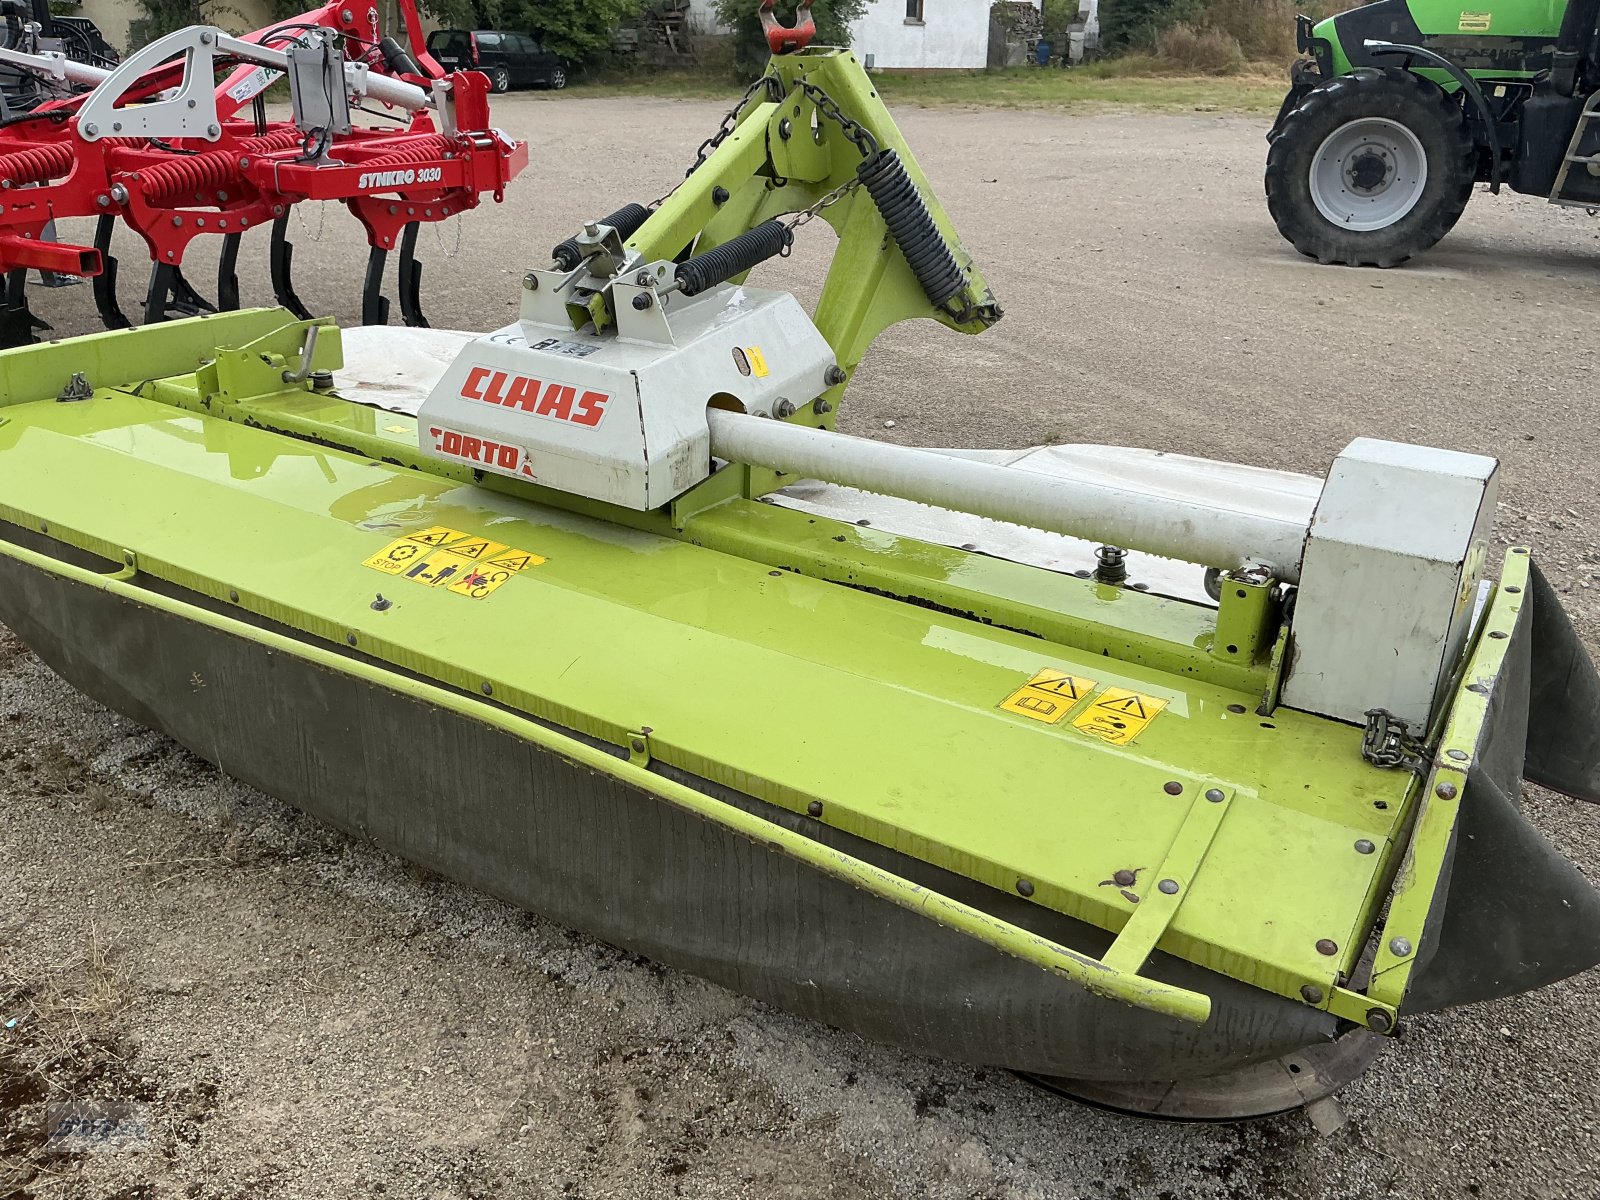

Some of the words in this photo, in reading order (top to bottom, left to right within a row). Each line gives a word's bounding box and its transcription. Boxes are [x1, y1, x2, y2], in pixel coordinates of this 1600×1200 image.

[358, 169, 415, 189] SYNKRO
[417, 167, 441, 183] 3030
[460, 366, 609, 427] CLAAS
[373, 558, 402, 570] STOP
